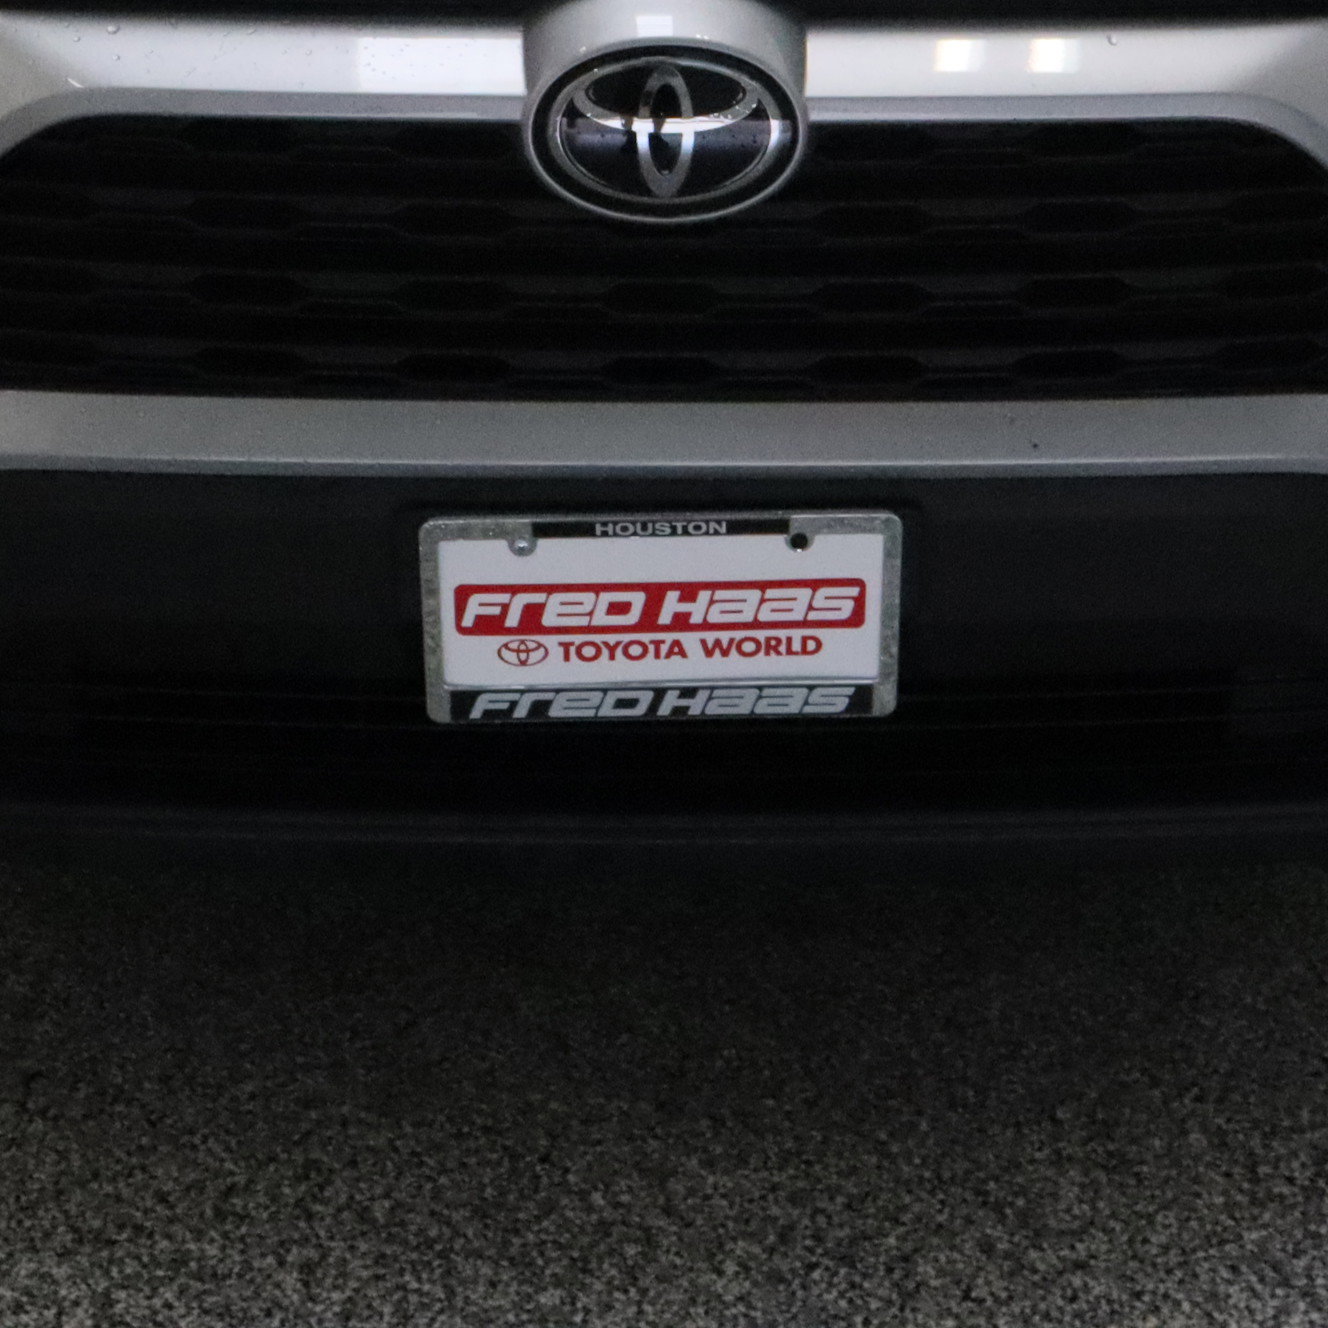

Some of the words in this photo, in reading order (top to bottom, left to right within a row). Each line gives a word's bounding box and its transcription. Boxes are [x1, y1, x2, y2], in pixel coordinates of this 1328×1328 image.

[595, 521, 728, 536] HOUSTON
[558, 639, 687, 663] TOYOTA
[701, 634, 823, 659] WORLD
